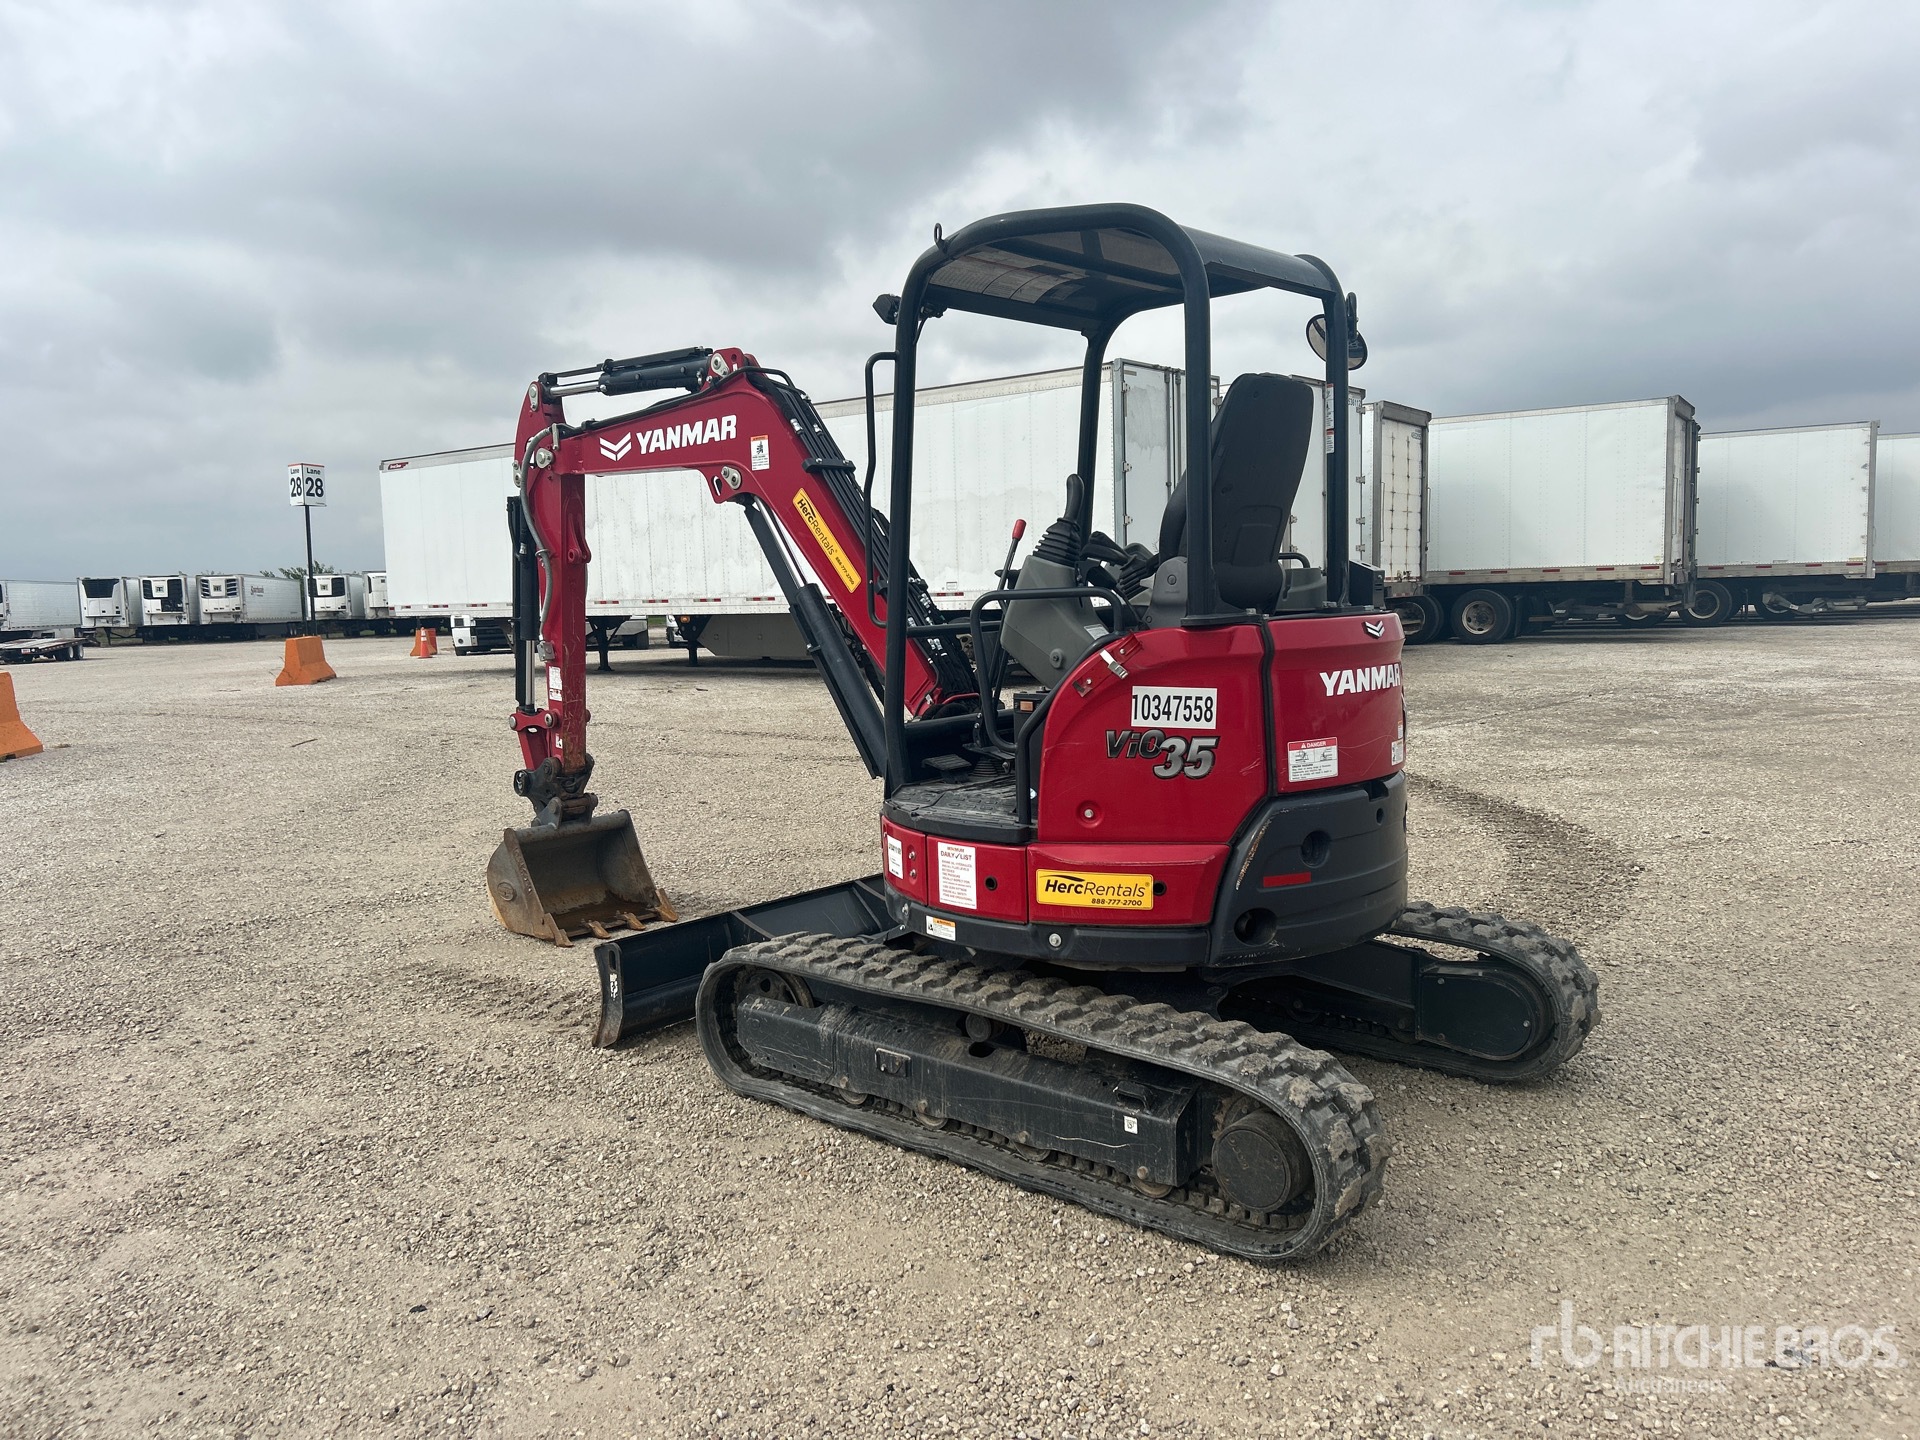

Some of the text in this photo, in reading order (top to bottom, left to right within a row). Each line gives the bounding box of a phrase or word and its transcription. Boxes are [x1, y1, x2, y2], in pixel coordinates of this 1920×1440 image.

[636, 414, 737, 455] YANMAR
[307, 467, 321, 475] Lane
[290, 477, 302, 497] 28
[305, 477, 324, 497] 28
[1320, 663, 1400, 697] YANMAR
[1132, 694, 1214, 723] 10347558
[940, 850, 955, 858] DAILY
[1091, 898, 1143, 907] 888-777-2700
